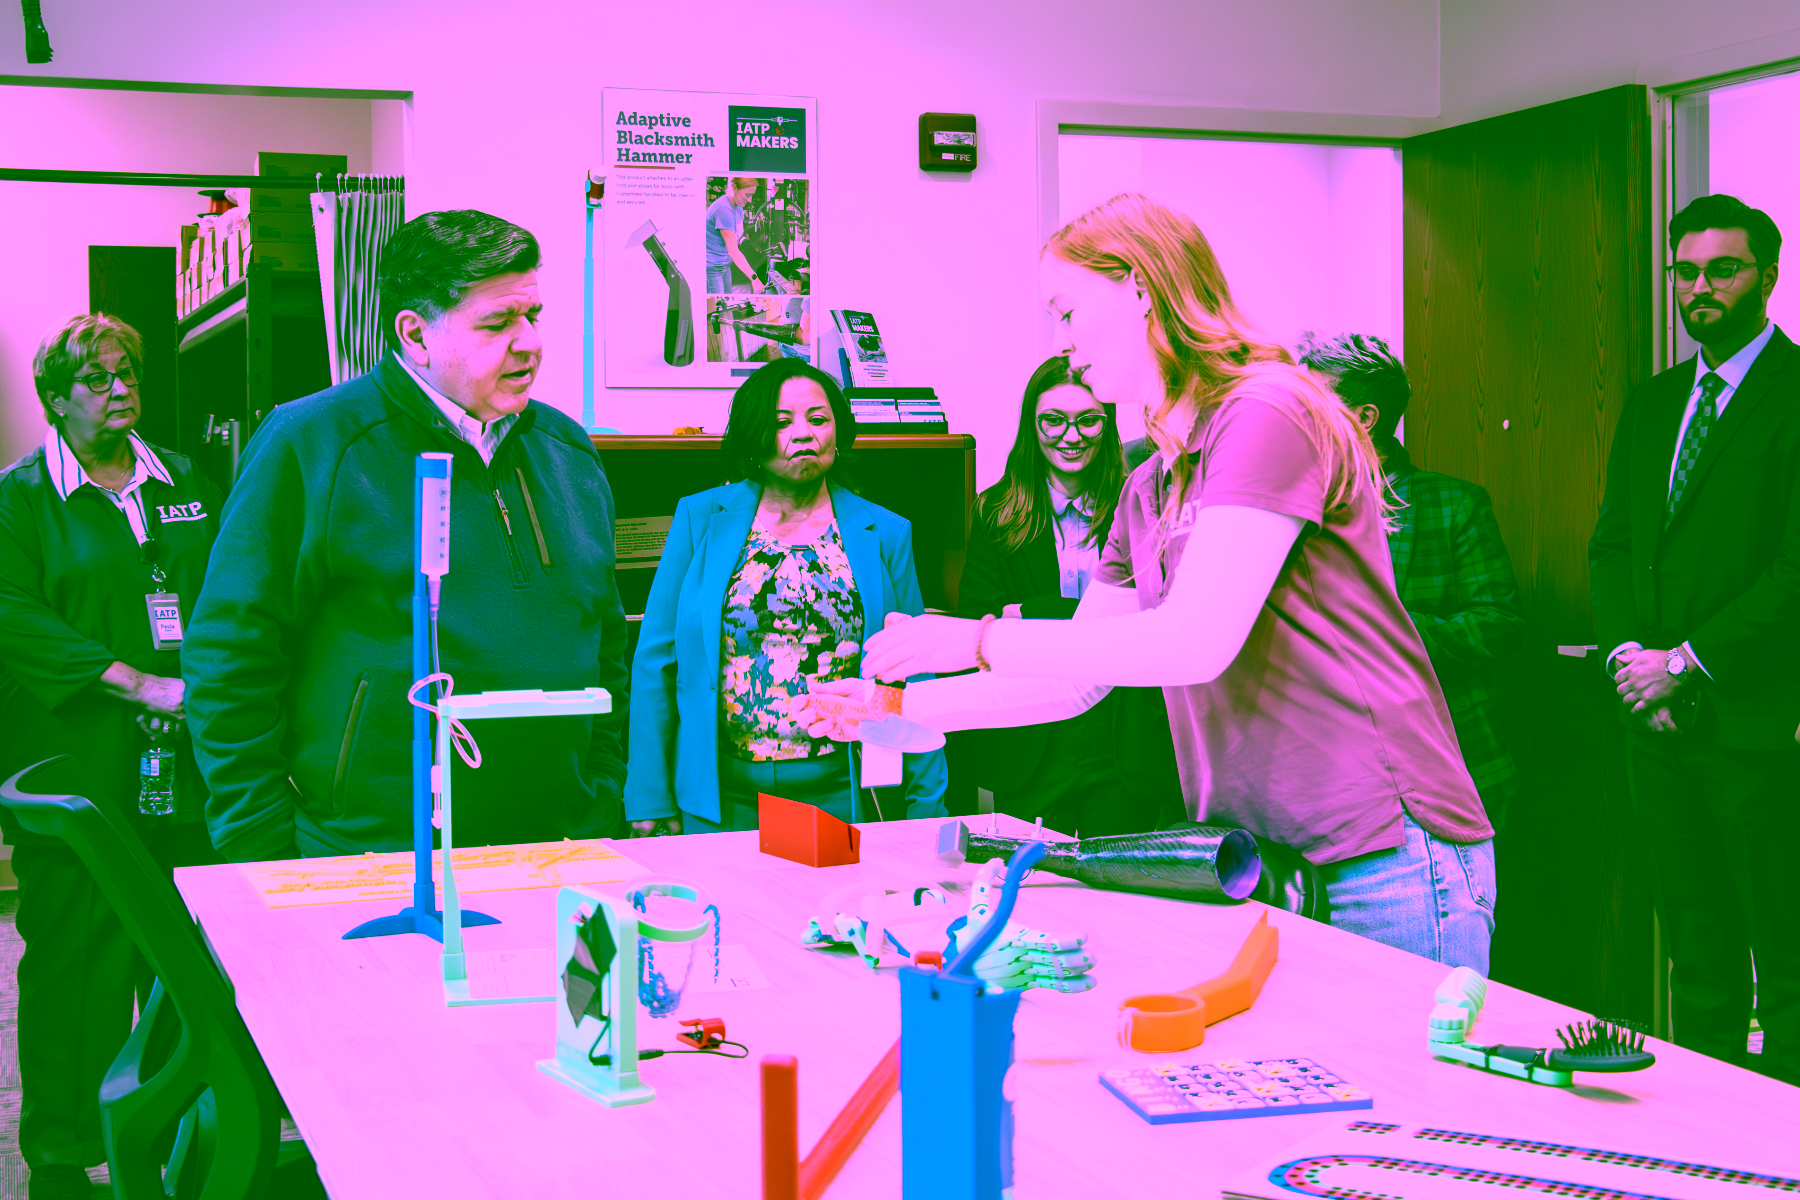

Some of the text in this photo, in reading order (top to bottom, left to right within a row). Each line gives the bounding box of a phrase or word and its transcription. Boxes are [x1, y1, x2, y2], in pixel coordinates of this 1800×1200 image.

[616, 111, 691, 130] Adaptive
[736, 122, 770, 134] IATP
[616, 130, 715, 148] Blacksmith
[736, 135, 799, 149] MAKERS
[616, 147, 693, 164] Hammer
[955, 153, 971, 162] FIRE
[156, 501, 202, 519] IATP
[154, 609, 177, 617] IATP
